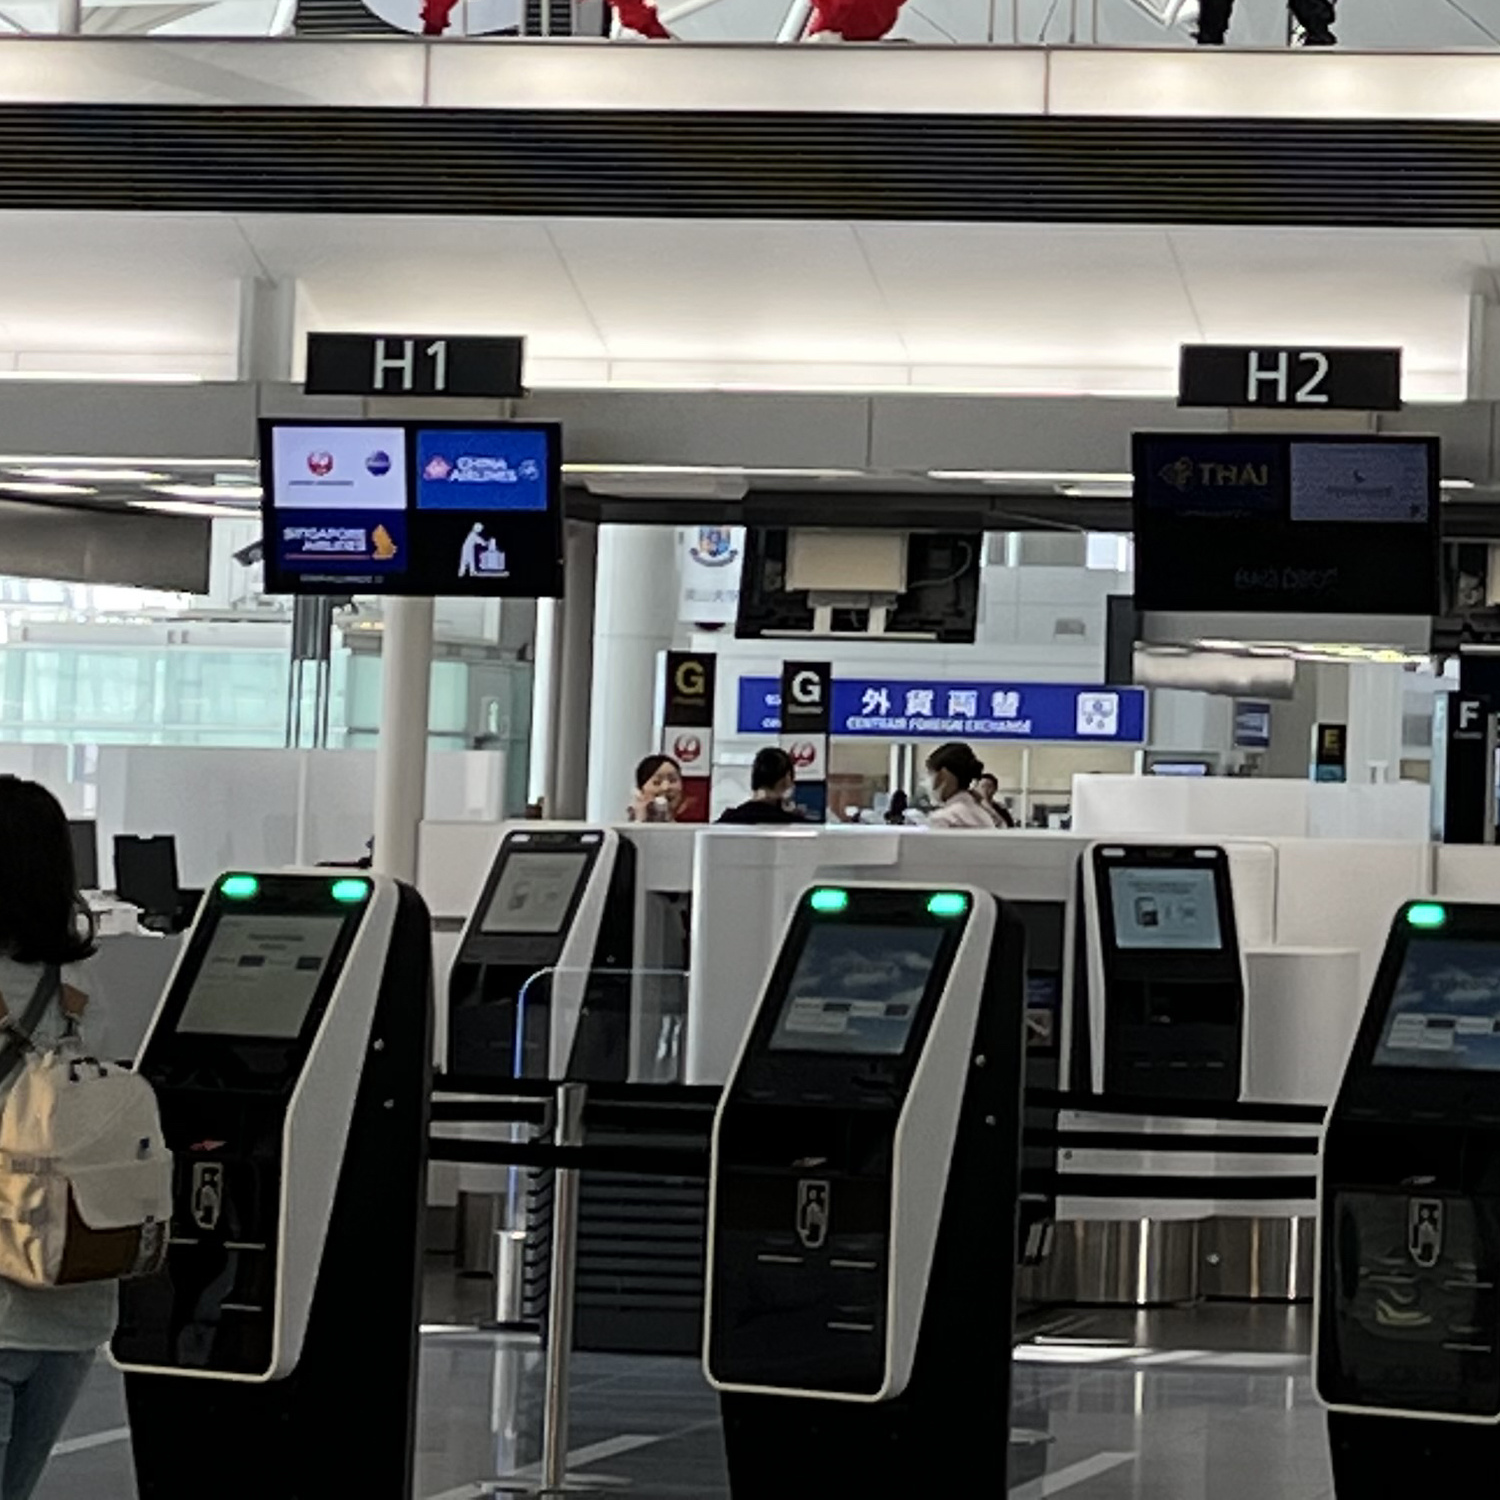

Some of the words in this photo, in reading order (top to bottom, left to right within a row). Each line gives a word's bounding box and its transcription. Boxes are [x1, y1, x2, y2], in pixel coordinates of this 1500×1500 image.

[373, 339, 447, 390] H1
[1247, 351, 1329, 403] H2
[1200, 462, 1268, 486] THAI
[675, 661, 705, 694] G
[792, 671, 822, 703] G
[1460, 702, 1480, 729] F
